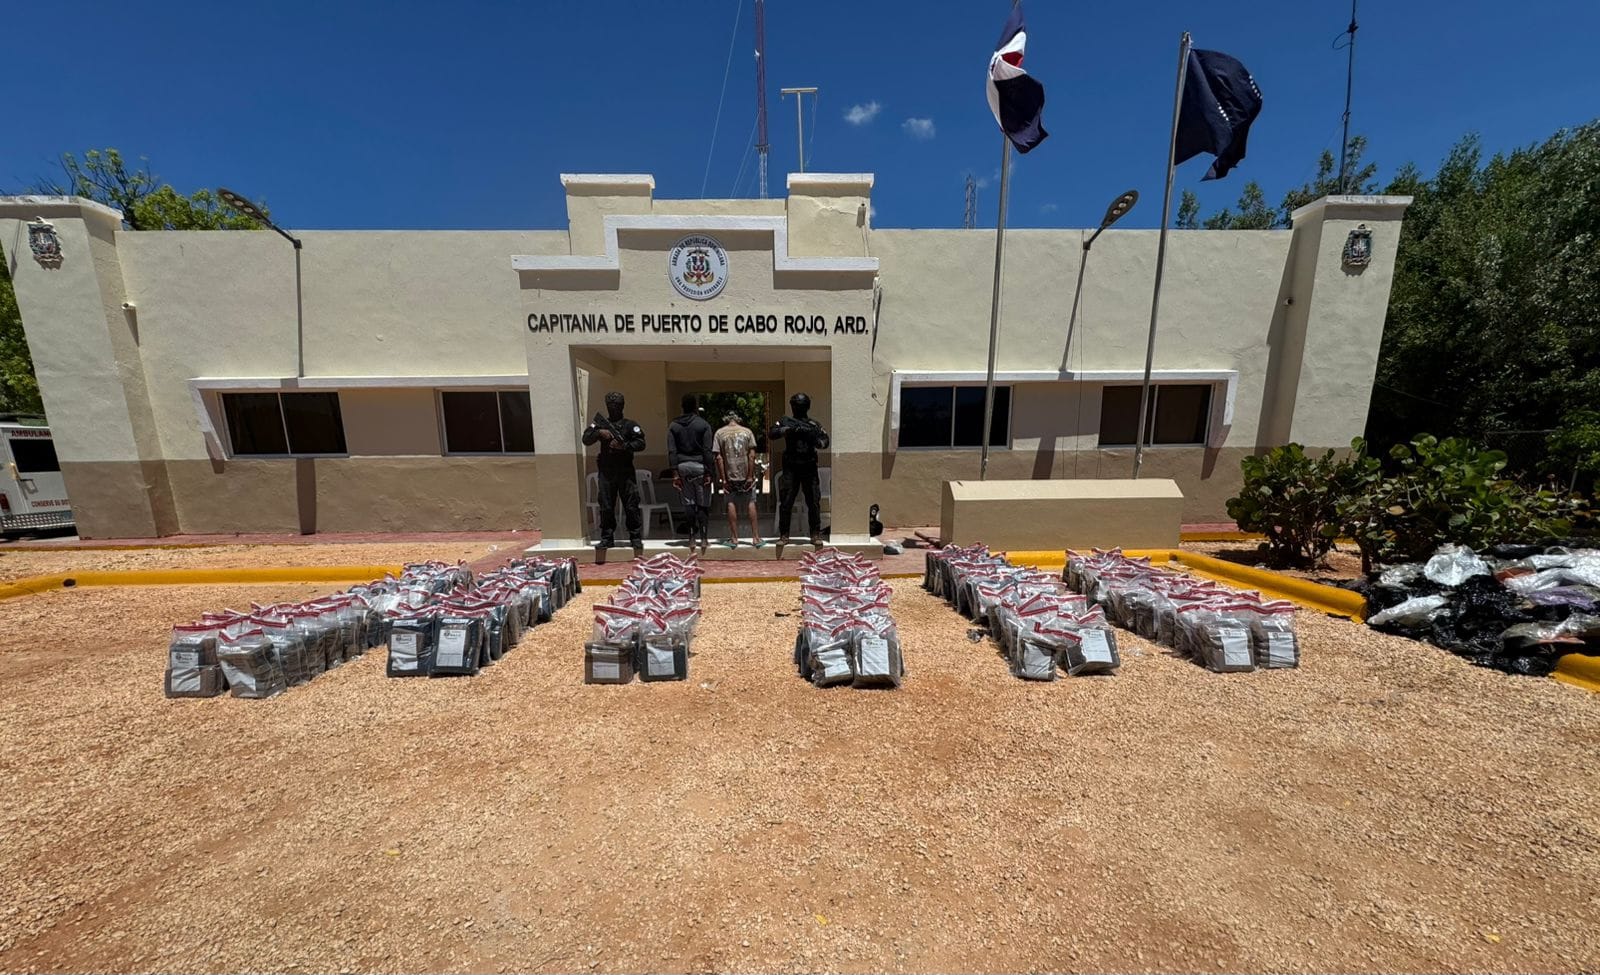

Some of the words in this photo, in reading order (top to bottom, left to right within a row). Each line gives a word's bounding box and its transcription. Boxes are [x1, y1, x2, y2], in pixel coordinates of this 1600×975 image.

[527, 313, 608, 332] CAPITANIA
[614, 314, 634, 332] DE
[641, 314, 702, 333] PUERTO
[708, 315, 728, 333] DE
[734, 315, 777, 333] CABO
[784, 315, 827, 336] ROJO,
[834, 316, 869, 334] ARD.
